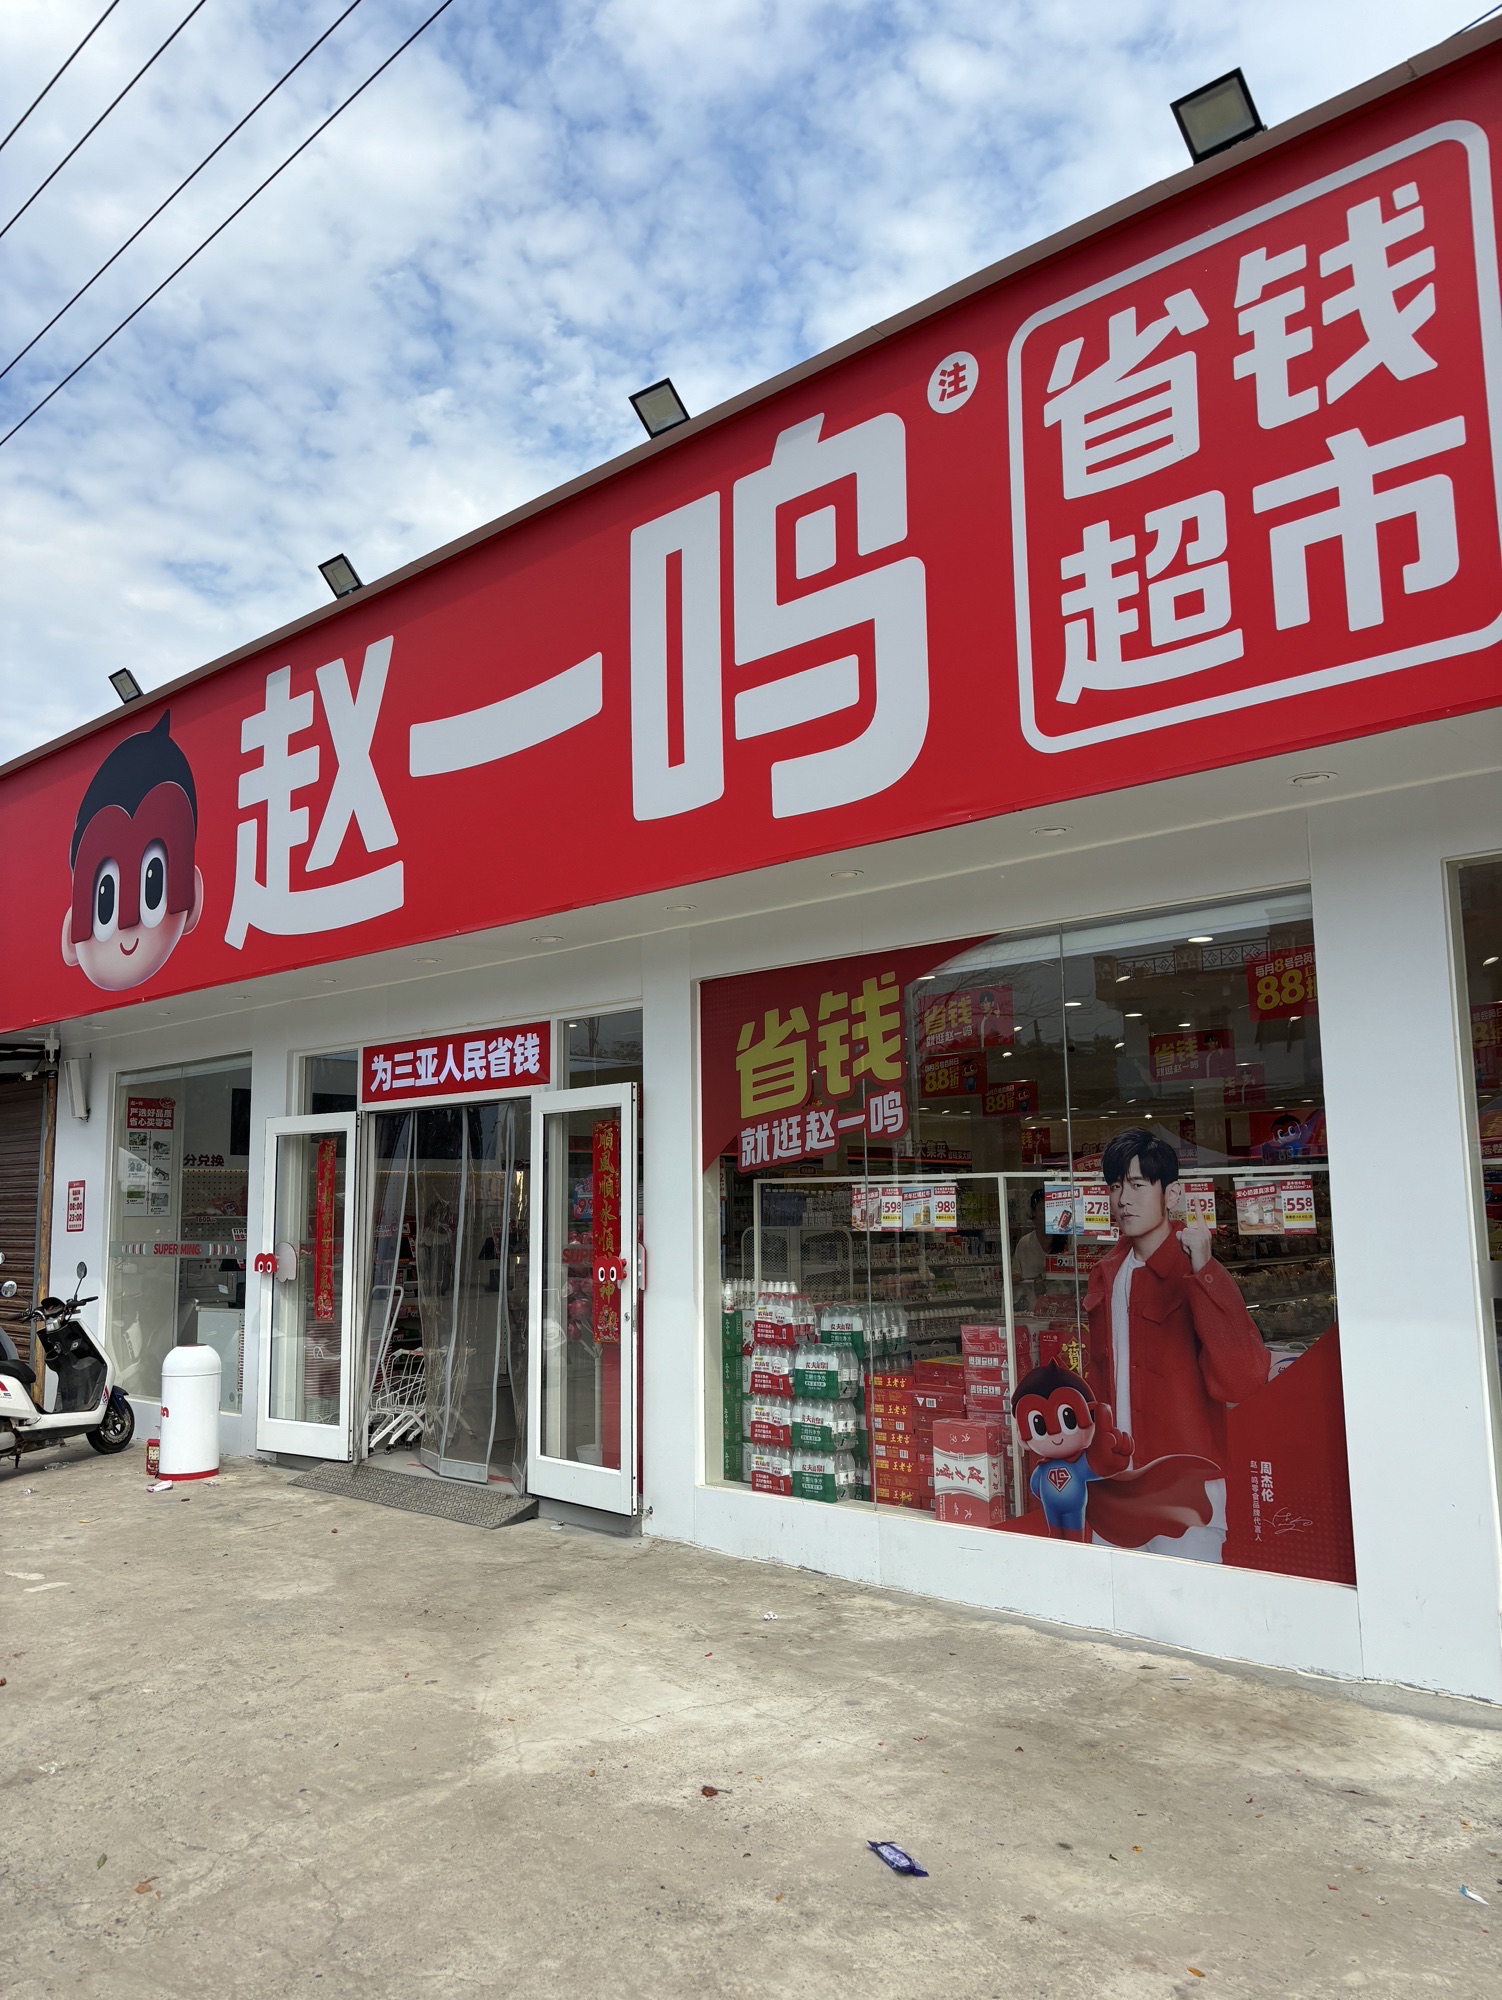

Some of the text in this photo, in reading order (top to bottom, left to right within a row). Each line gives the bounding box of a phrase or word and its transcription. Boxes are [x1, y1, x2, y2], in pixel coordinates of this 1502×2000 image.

[1042, 179, 1440, 501] 省钱
[937, 361, 969, 403] 注
[1053, 414, 1468, 705] 超市
[223, 409, 931, 951] 赵一鸣
[1254, 951, 1315, 978] 每月8号会员
[923, 995, 973, 1036] 省钱
[369, 1032, 541, 1093] 为三亚人民省钱
[735, 970, 902, 1119] 省钱
[1154, 1036, 1199, 1068] 省钱
[129, 1108, 173, 1118] 严选好品质
[129, 1117, 173, 1128] 省心买零食
[740, 1090, 904, 1168] 就逛赵一鸣
[69, 1202, 83, 1211] 08:00
[69, 1213, 82, 1222] 23:00
[597, 1128, 618, 1304] 順風順水順神
[153, 1243, 201, 1256] SUPER MING
[885, 1377, 907, 1388] 王老吉
[887, 1404, 908, 1415] 王老吉
[890, 1433, 911, 1445] 王老吉
[892, 1461, 914, 1473] 王老吉
[1260, 1461, 1274, 1503] 周杰伦
[1249, 1460, 1263, 1542] 赵一鸣零食品牌代言人
